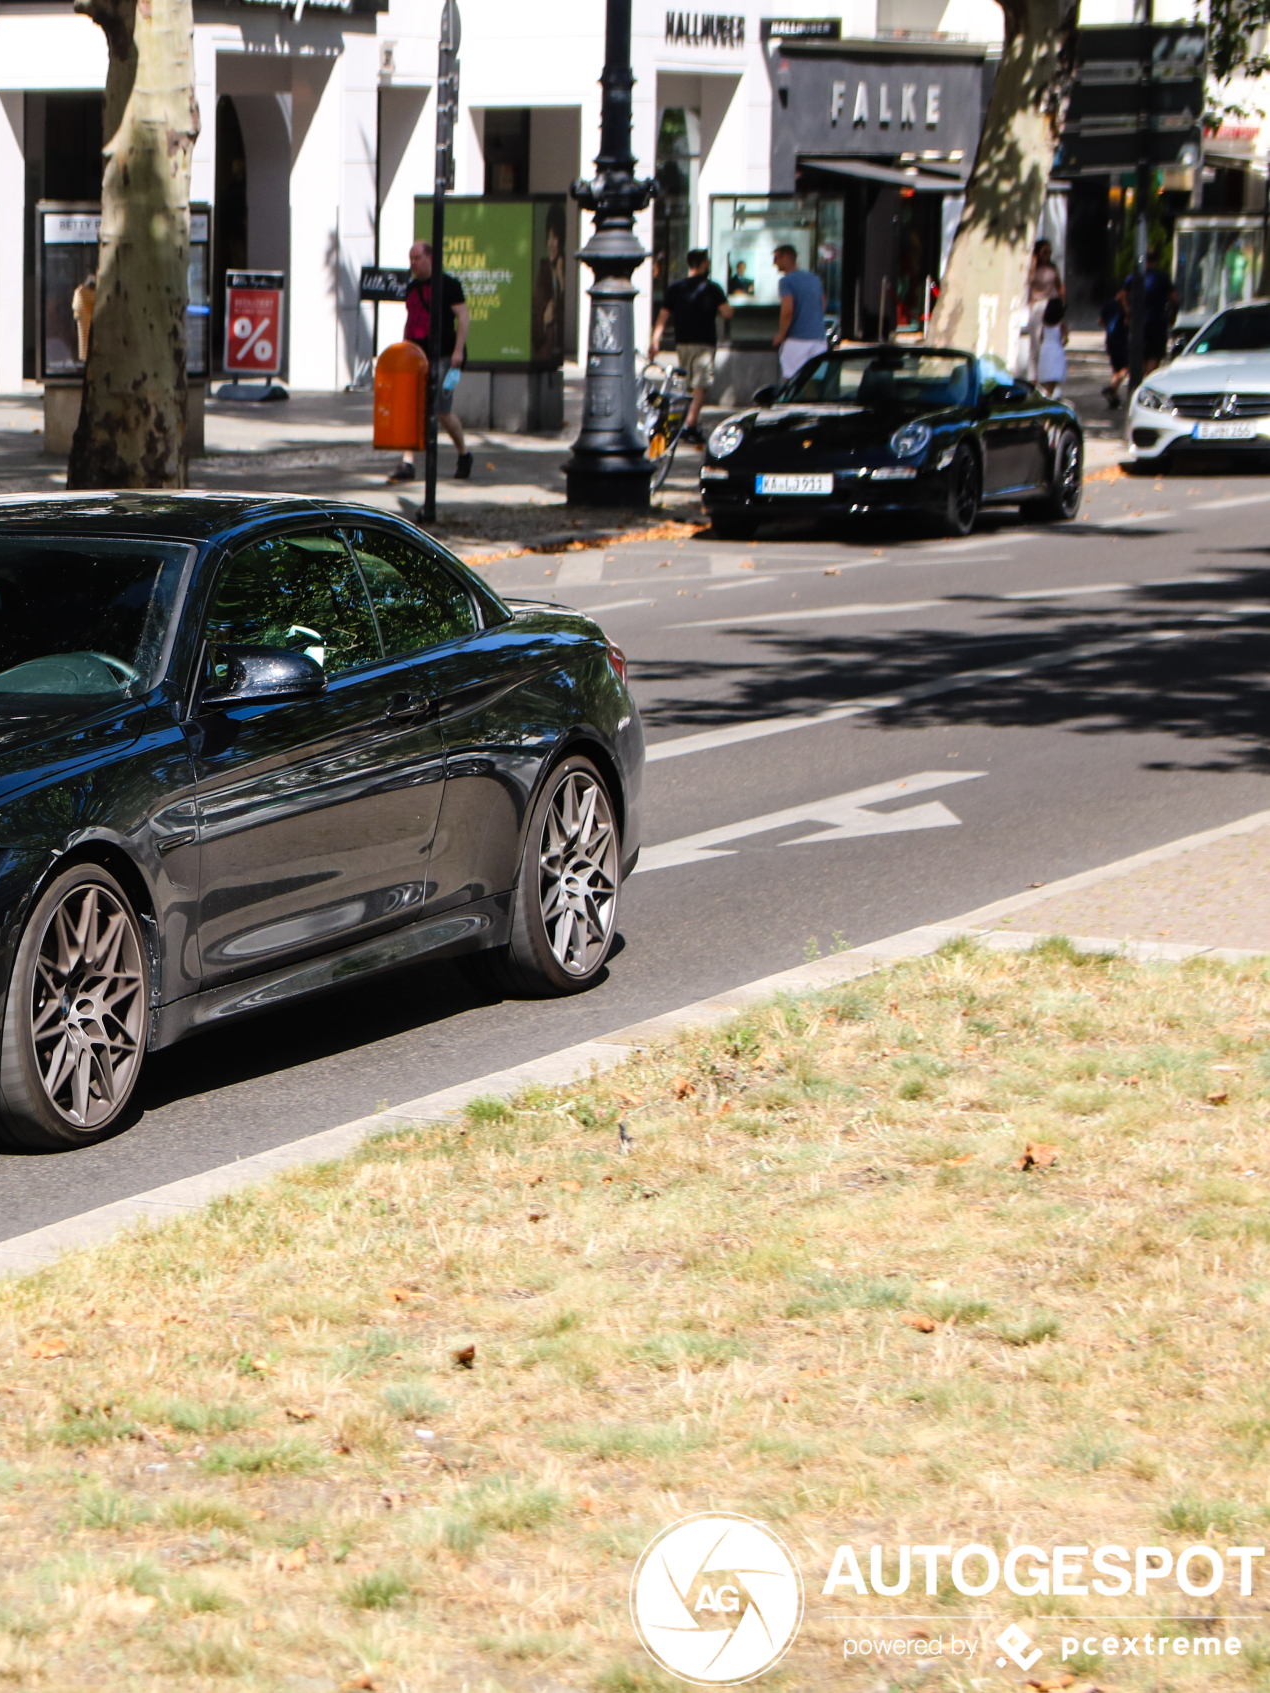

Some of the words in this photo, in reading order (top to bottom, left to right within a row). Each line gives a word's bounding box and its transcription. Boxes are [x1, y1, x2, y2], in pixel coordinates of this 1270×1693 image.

[665, 11, 745, 45] HALLHUBER
[770, 20, 830, 35] HALLHUBER
[832, 81, 940, 125] FALKE
[60, 220, 91, 231] BETTY
[443, 235, 474, 253] CHTE
[443, 253, 486, 269] RAUEN
[803, 476, 822, 492] 911
